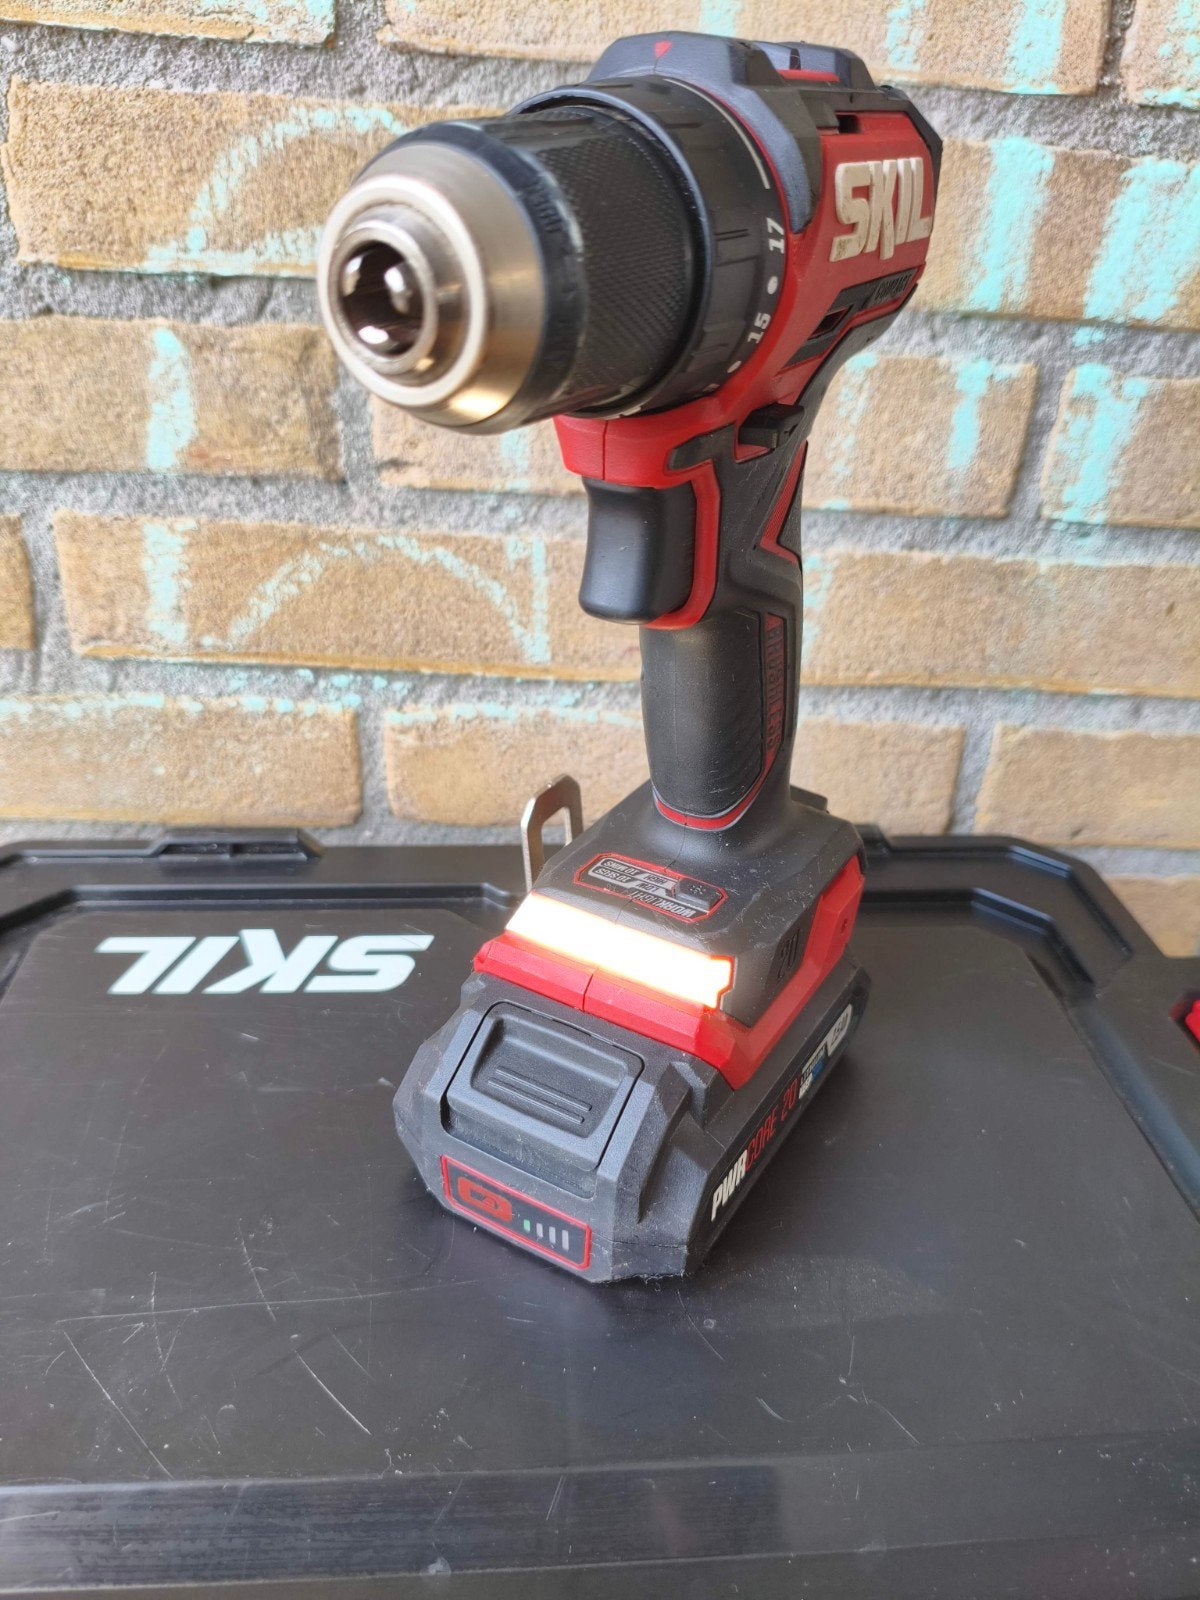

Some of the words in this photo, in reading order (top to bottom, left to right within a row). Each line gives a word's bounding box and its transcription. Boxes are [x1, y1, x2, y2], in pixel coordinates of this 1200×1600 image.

[829, 157, 932, 261] SKIL
[766, 217, 785, 254] 17
[747, 312, 771, 344] 15
[95, 929, 435, 994] SKIL
